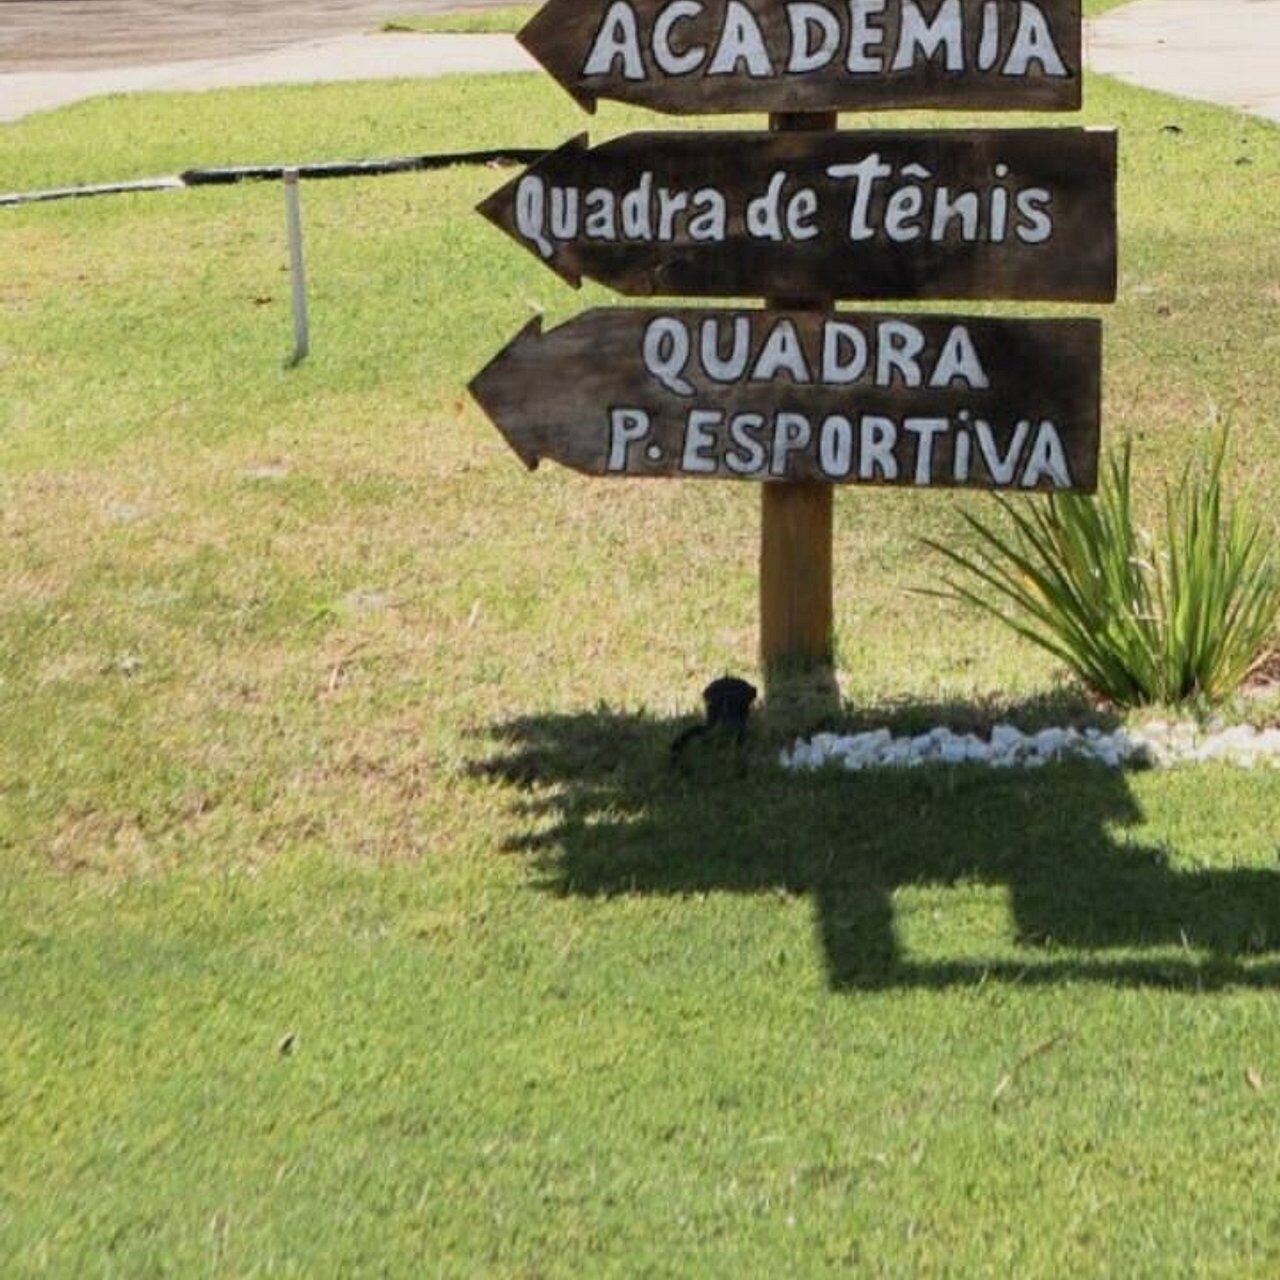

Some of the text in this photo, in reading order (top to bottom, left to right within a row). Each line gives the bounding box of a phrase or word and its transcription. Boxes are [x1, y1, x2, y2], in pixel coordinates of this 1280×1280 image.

[516, 154, 1052, 256] Quadra de Tênis
[642, 318, 989, 395] QUADRA
[608, 409, 660, 470] P.
